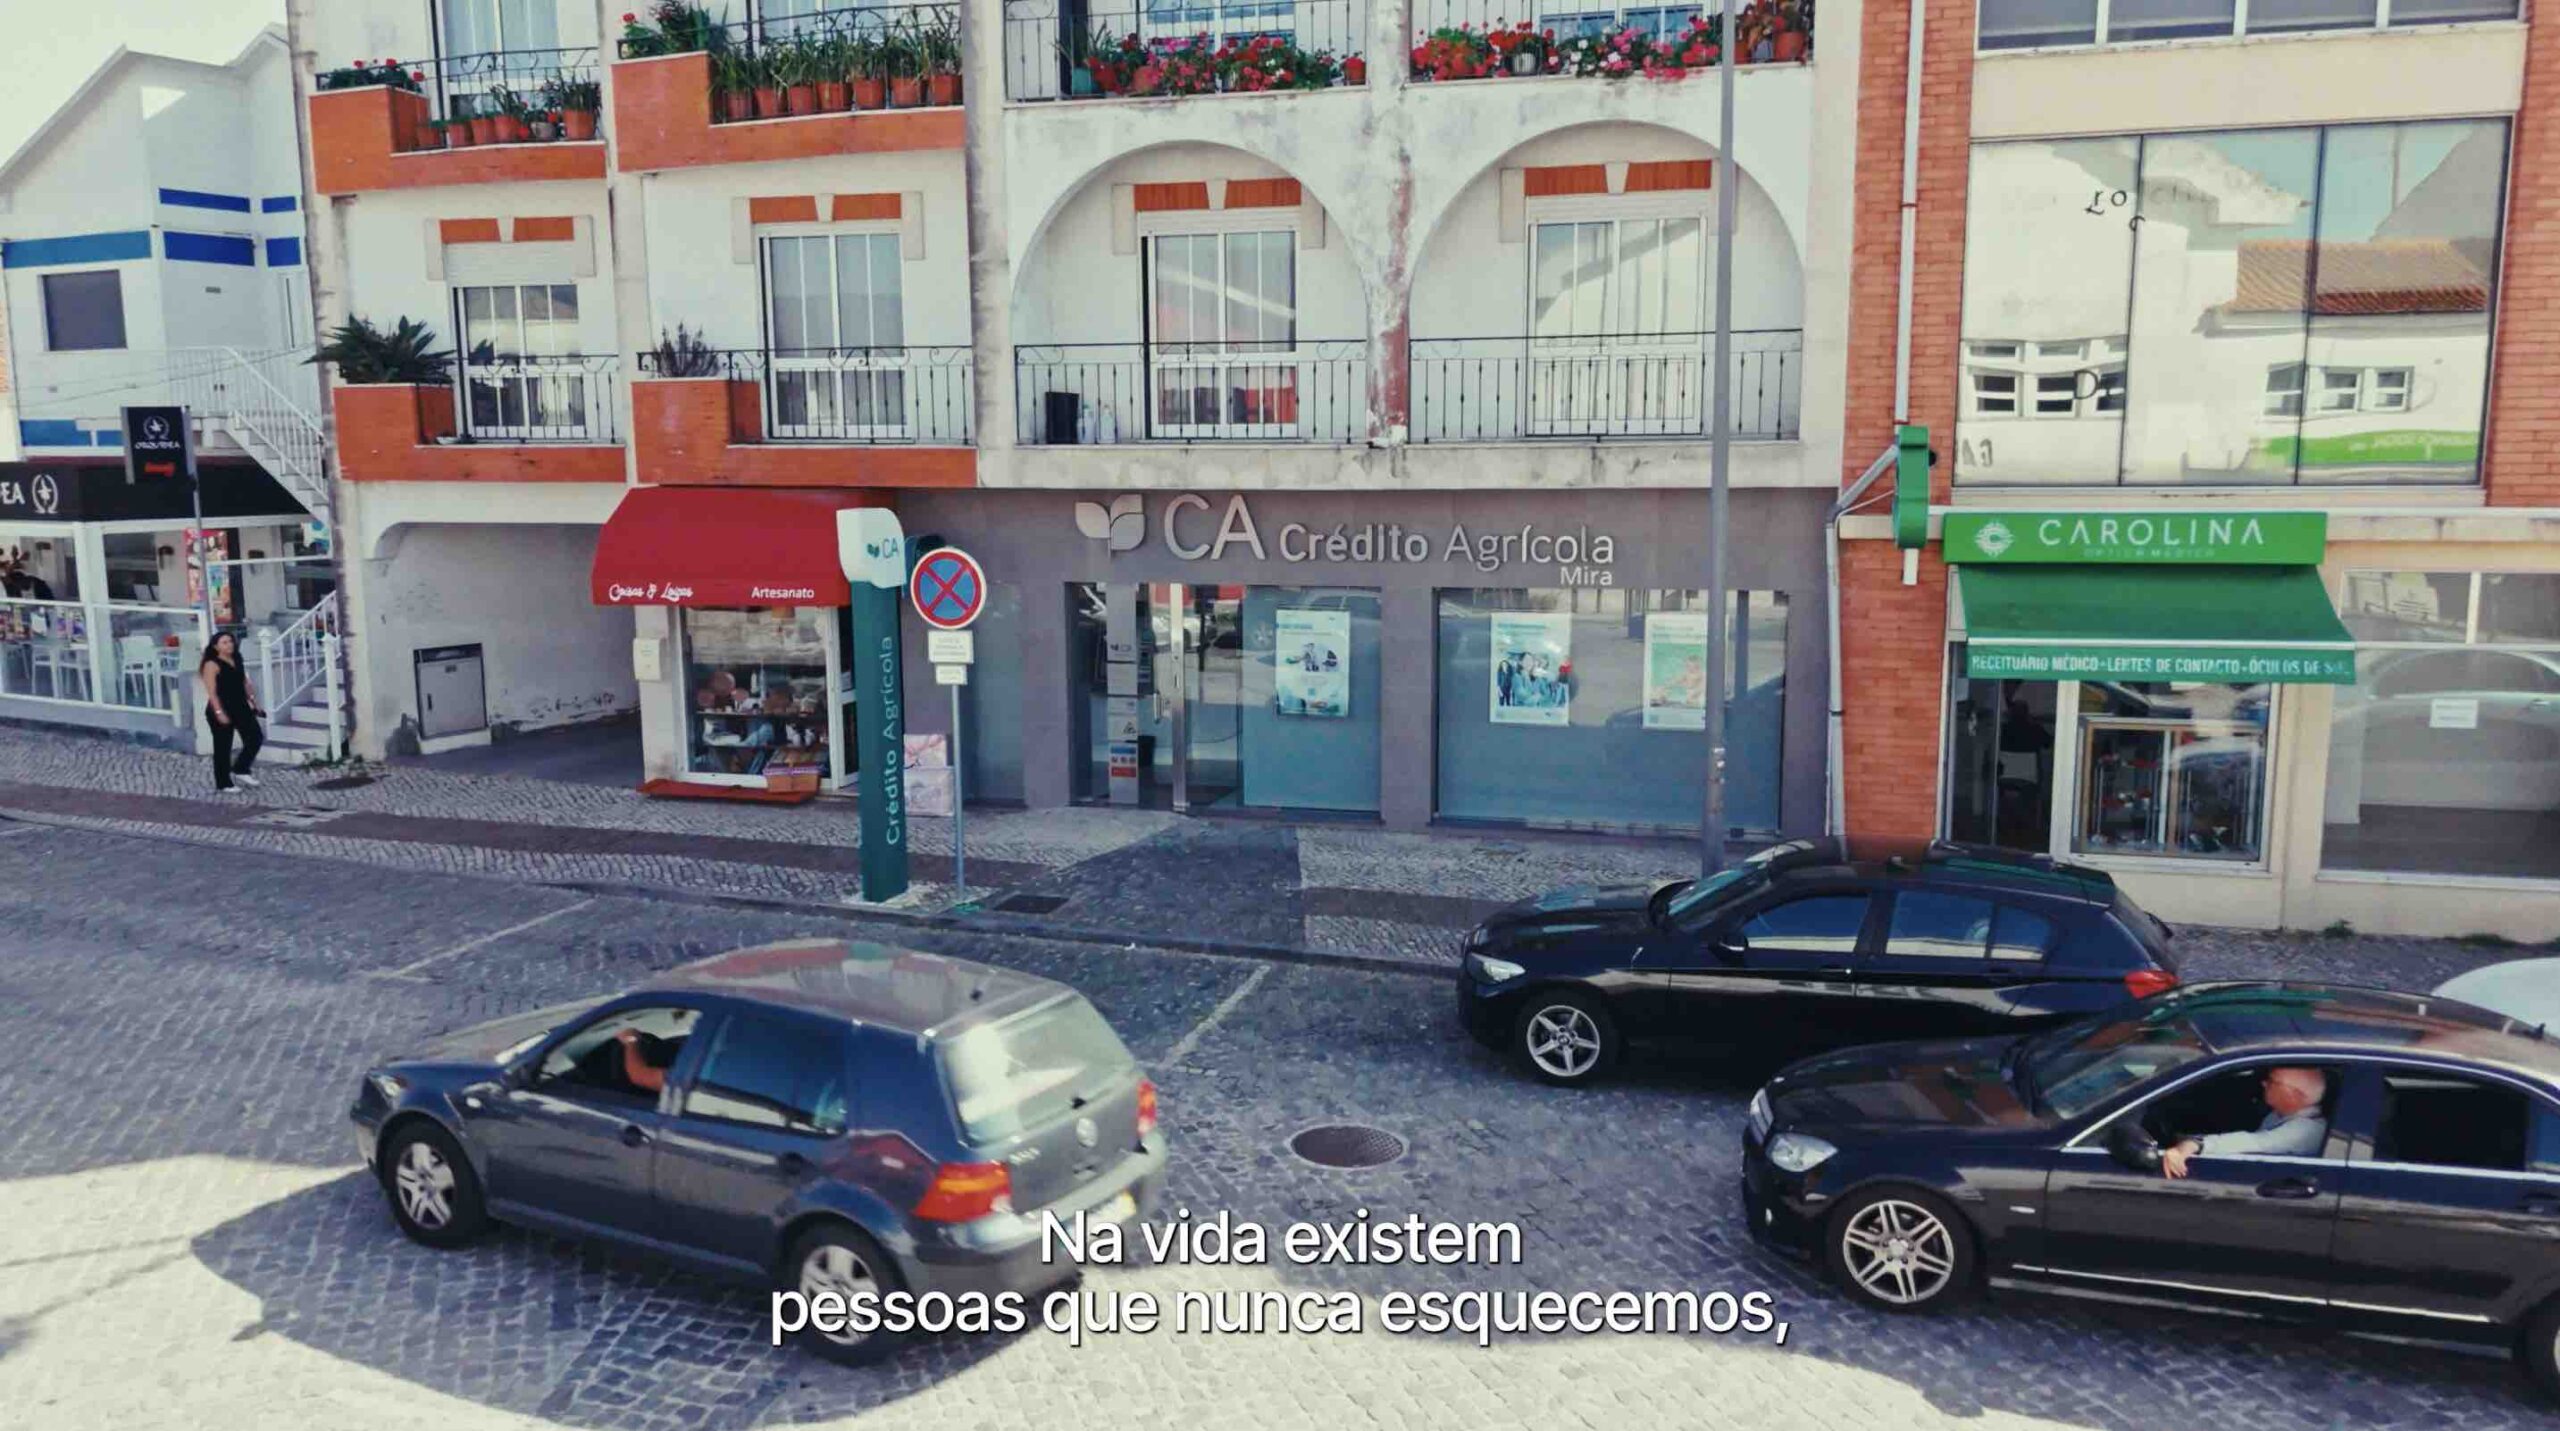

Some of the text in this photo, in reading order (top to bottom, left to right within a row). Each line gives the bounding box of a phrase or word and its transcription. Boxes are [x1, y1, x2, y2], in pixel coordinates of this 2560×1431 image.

[1163, 493, 1614, 571] CA Crédito Agrícola
[2038, 519, 2265, 546] CAROLINA
[882, 537, 899, 559] CA
[1559, 567, 1614, 586] Mira
[751, 587, 816, 600] Artesanato
[2155, 658, 2172, 674] DE
[879, 636, 900, 845] Crédito Agrícola
